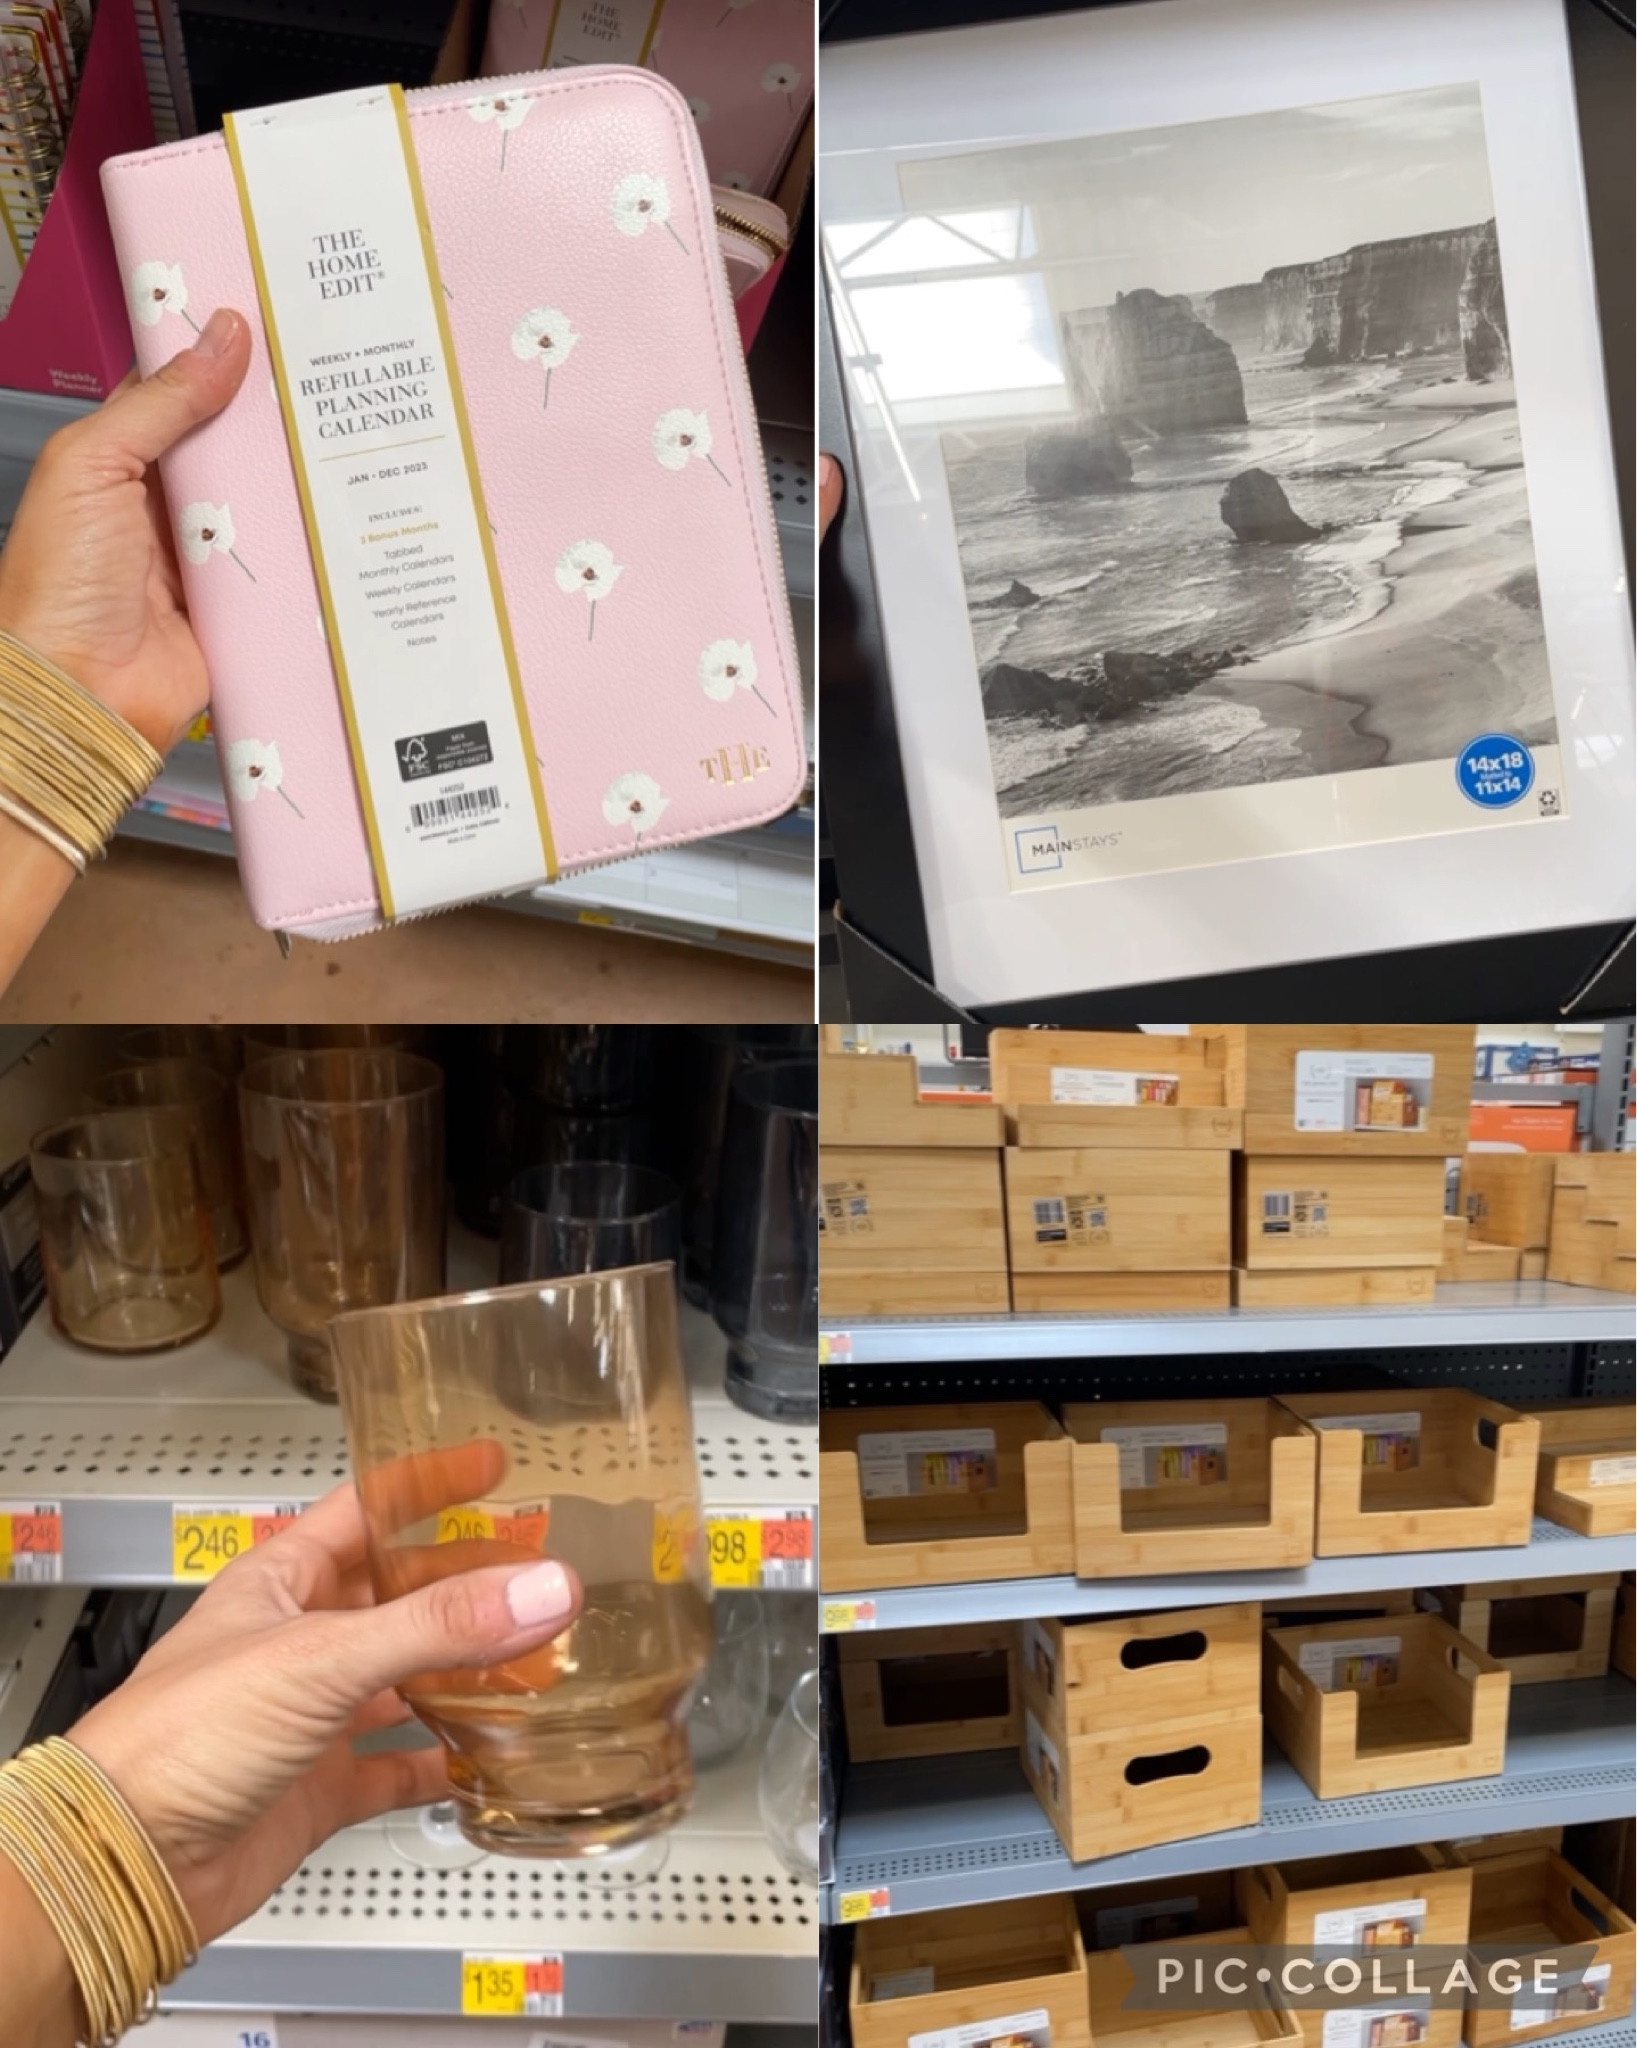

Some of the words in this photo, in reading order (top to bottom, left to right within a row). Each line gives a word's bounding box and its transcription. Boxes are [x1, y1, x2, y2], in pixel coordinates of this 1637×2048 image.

[312, 228, 366, 254] THE
[307, 249, 382, 280] HOME
[310, 351, 352, 367] WEEKLY
[363, 338, 416, 357] MONTHLY
[300, 355, 436, 397] REFILLABLE
[316, 380, 429, 417] PLANNING
[318, 402, 435, 439] CALENDAR
[347, 473, 370, 486] JAN
[378, 466, 401, 480] DEC
[403, 461, 428, 475] 2023
[384, 545, 423, 560] Tabbed
[359, 565, 399, 580] Monthly
[402, 554, 455, 572] Calendars
[364, 585, 402, 600] Weekly
[403, 574, 456, 592] Calendars
[372, 604, 405, 619] Yearly
[405, 594, 457, 612] Reference
[390, 612, 445, 631] Calendars
[406, 635, 438, 647] Notes
[1467, 751, 1525, 775] 14x18
[1474, 777, 1523, 796] 11x14
